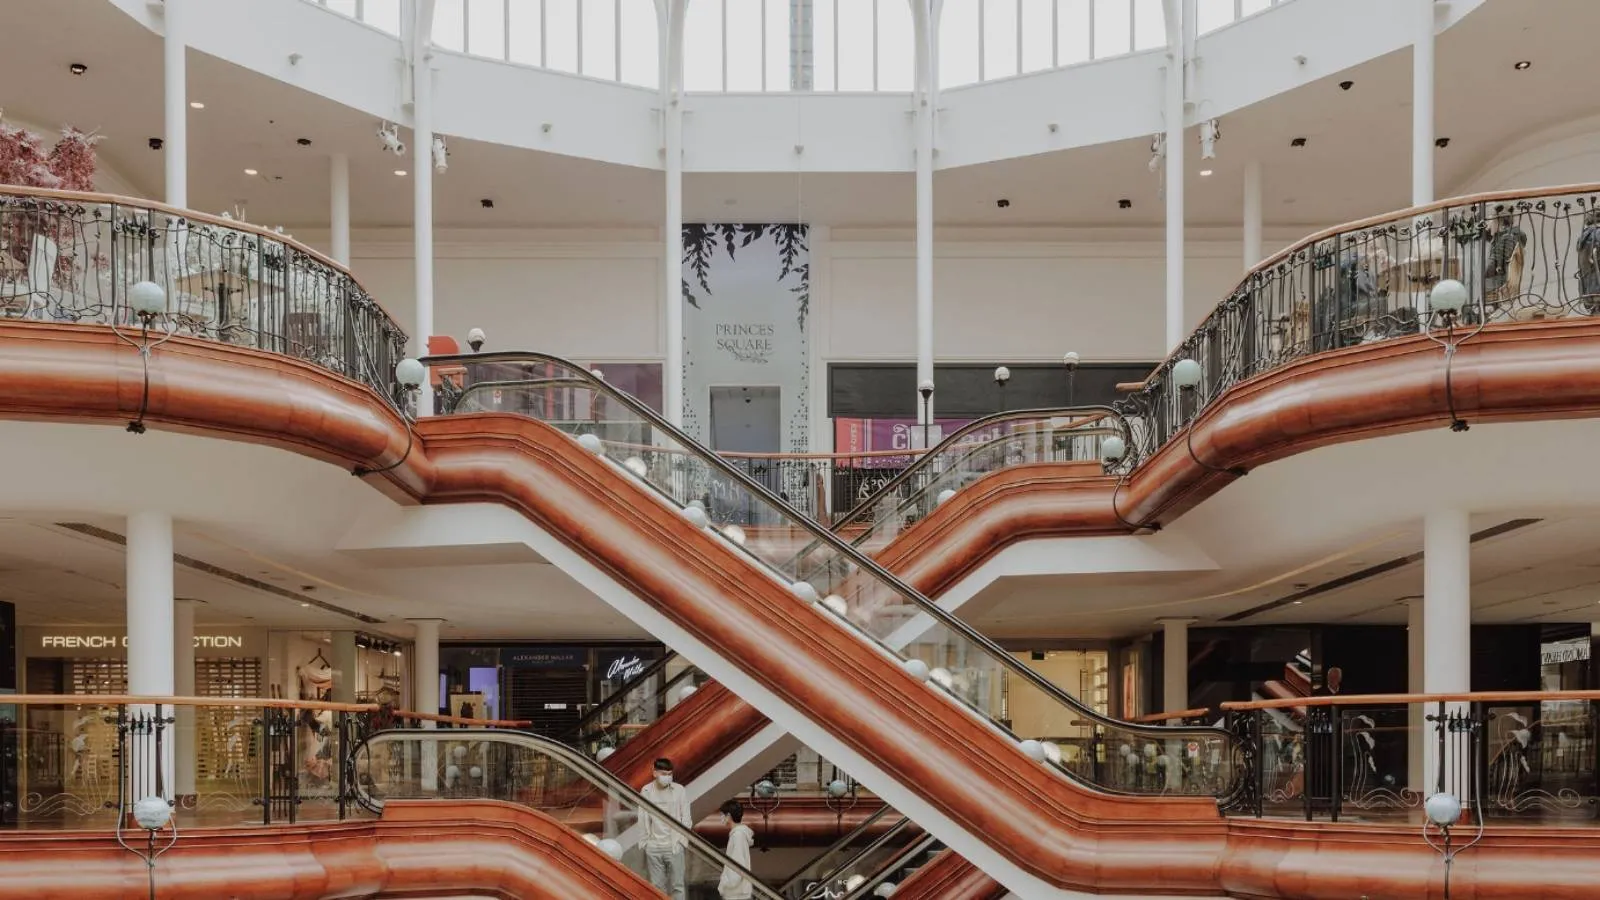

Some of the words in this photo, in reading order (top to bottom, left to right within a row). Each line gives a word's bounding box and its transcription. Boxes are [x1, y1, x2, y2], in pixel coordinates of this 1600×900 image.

[715, 323, 775, 336] PRINCES
[716, 338, 773, 352] SQUARE
[42, 636, 116, 648] FRENCH
